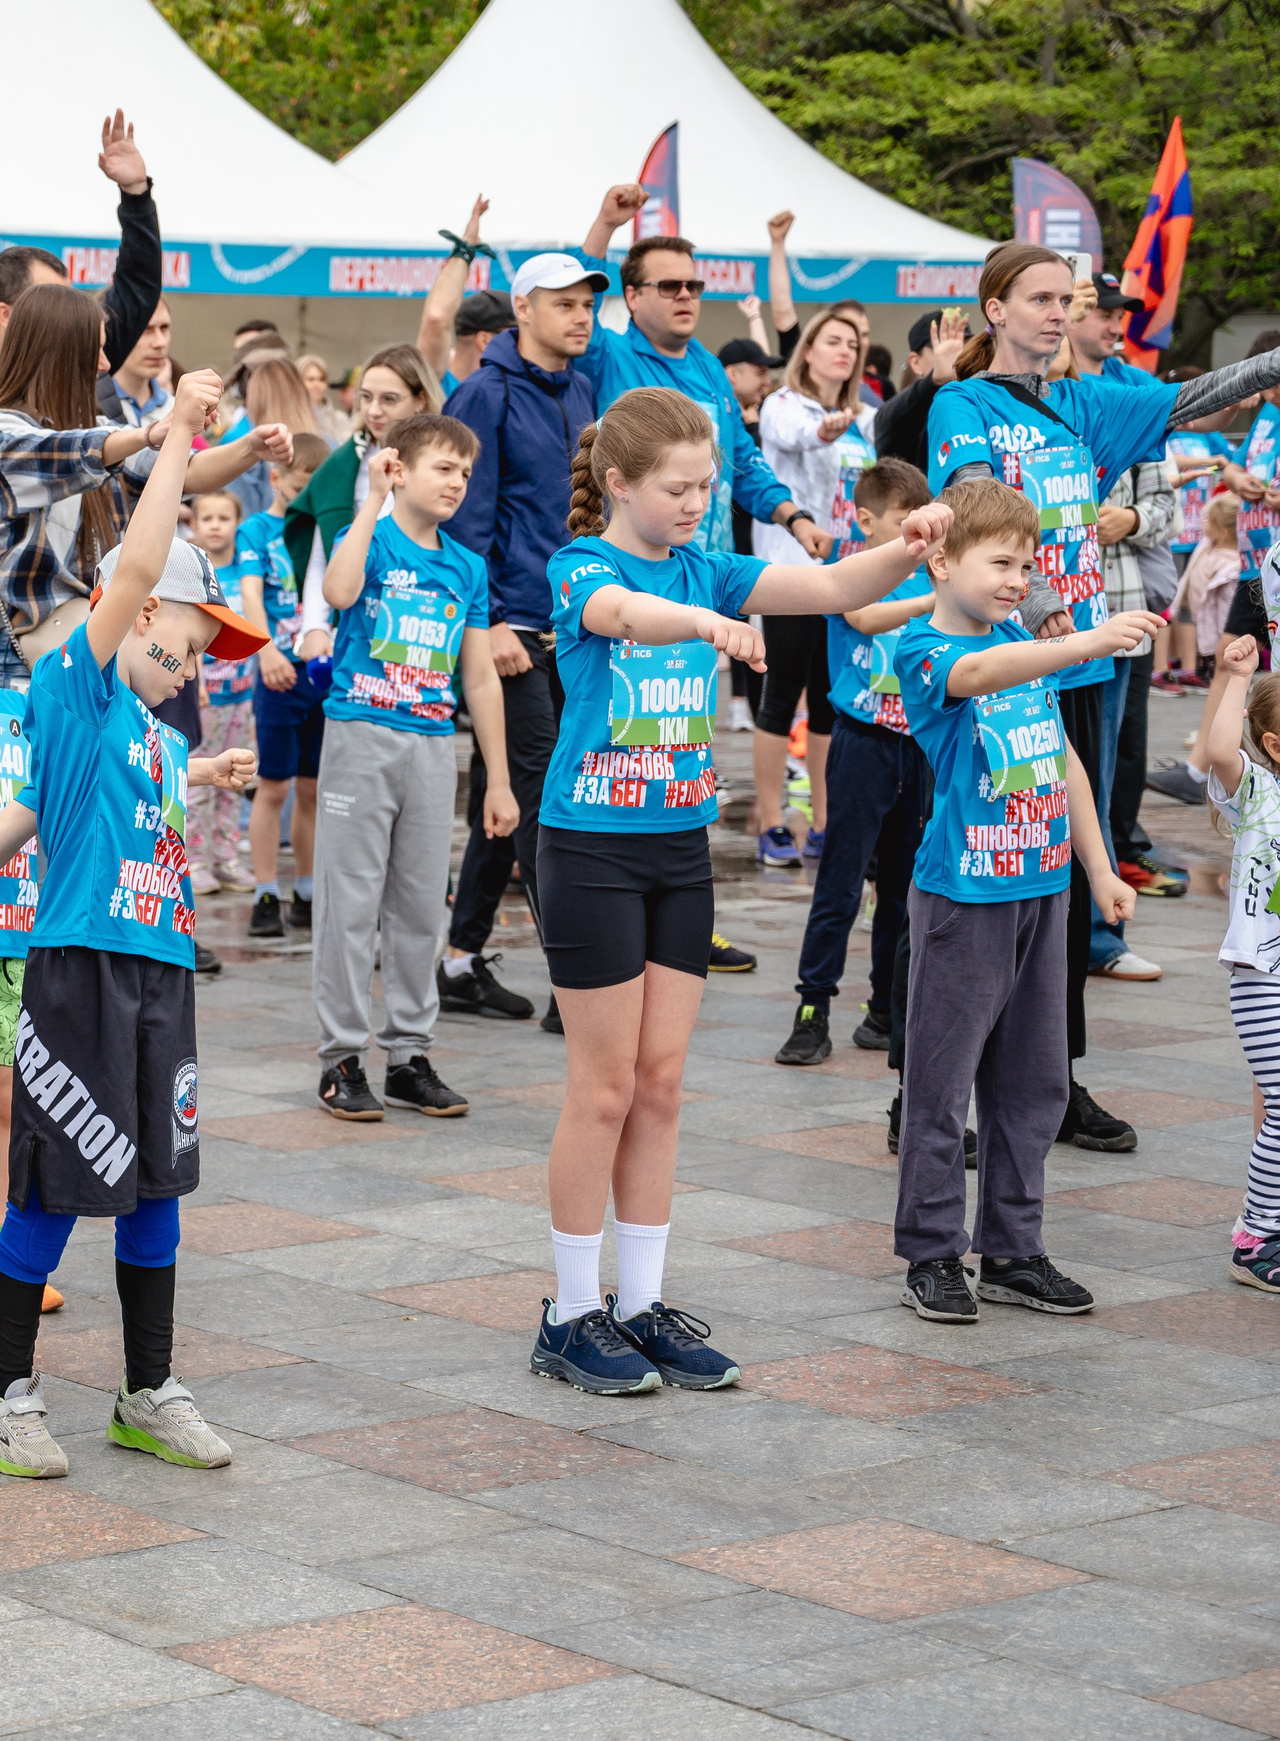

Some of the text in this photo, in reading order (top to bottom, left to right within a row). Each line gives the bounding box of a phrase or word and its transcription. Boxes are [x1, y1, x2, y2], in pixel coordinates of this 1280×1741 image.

[989, 424, 1046, 454] 2024
[1043, 473, 1090, 504] 10048
[398, 615, 447, 649] 10153
[633, 650, 652, 658] ПСБ
[639, 676, 704, 713] 10040
[853, 689, 906, 715] #ЗАБЕ
[994, 703, 1011, 713] ПСБ
[1007, 719, 1060, 761] 10250
[581, 751, 675, 779] #ЛЮБОВЬ
[573, 777, 647, 807] #ЗАБЕГ
[966, 821, 1050, 850] #ЛЮБОВЬ
[959, 850, 1024, 877] #ЗАБЕГ
